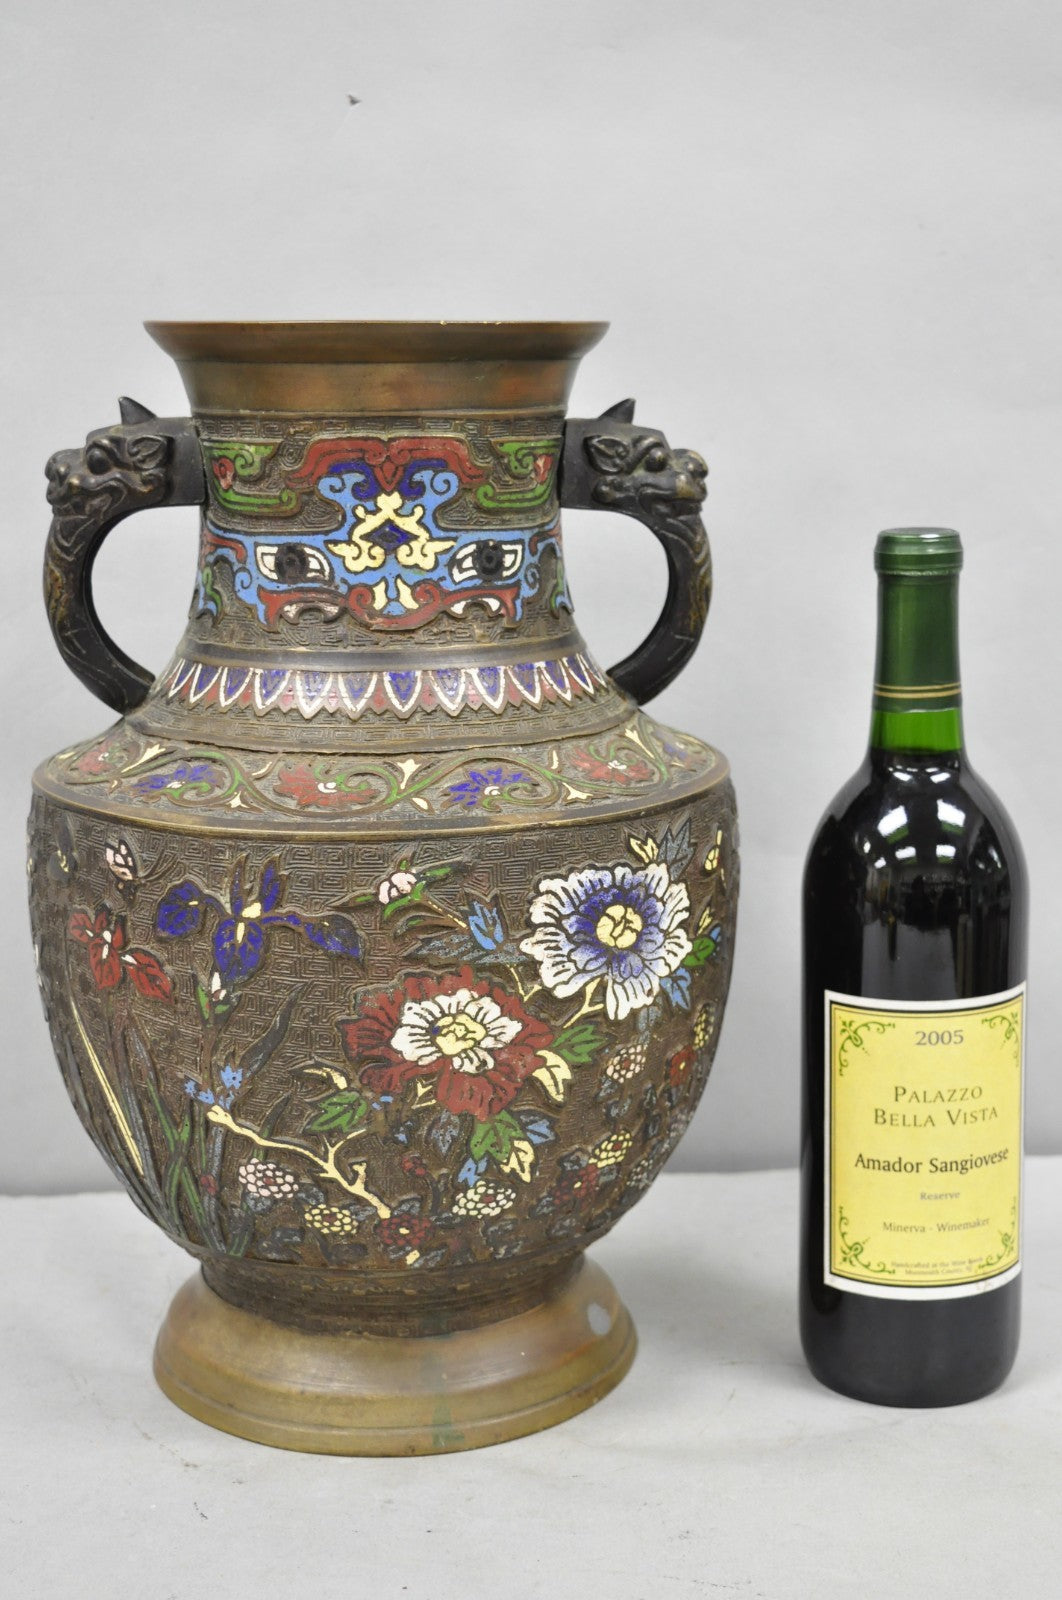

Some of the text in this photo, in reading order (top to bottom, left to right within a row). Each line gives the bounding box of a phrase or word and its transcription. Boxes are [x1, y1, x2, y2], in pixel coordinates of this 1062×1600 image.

[916, 1029, 964, 1046] 2005
[854, 1147, 1009, 1175] Amador Sangiovese
[920, 1191, 960, 1201] Reserve
[883, 1221, 926, 1233] Minerva
[936, 1217, 991, 1233] Winemaker
